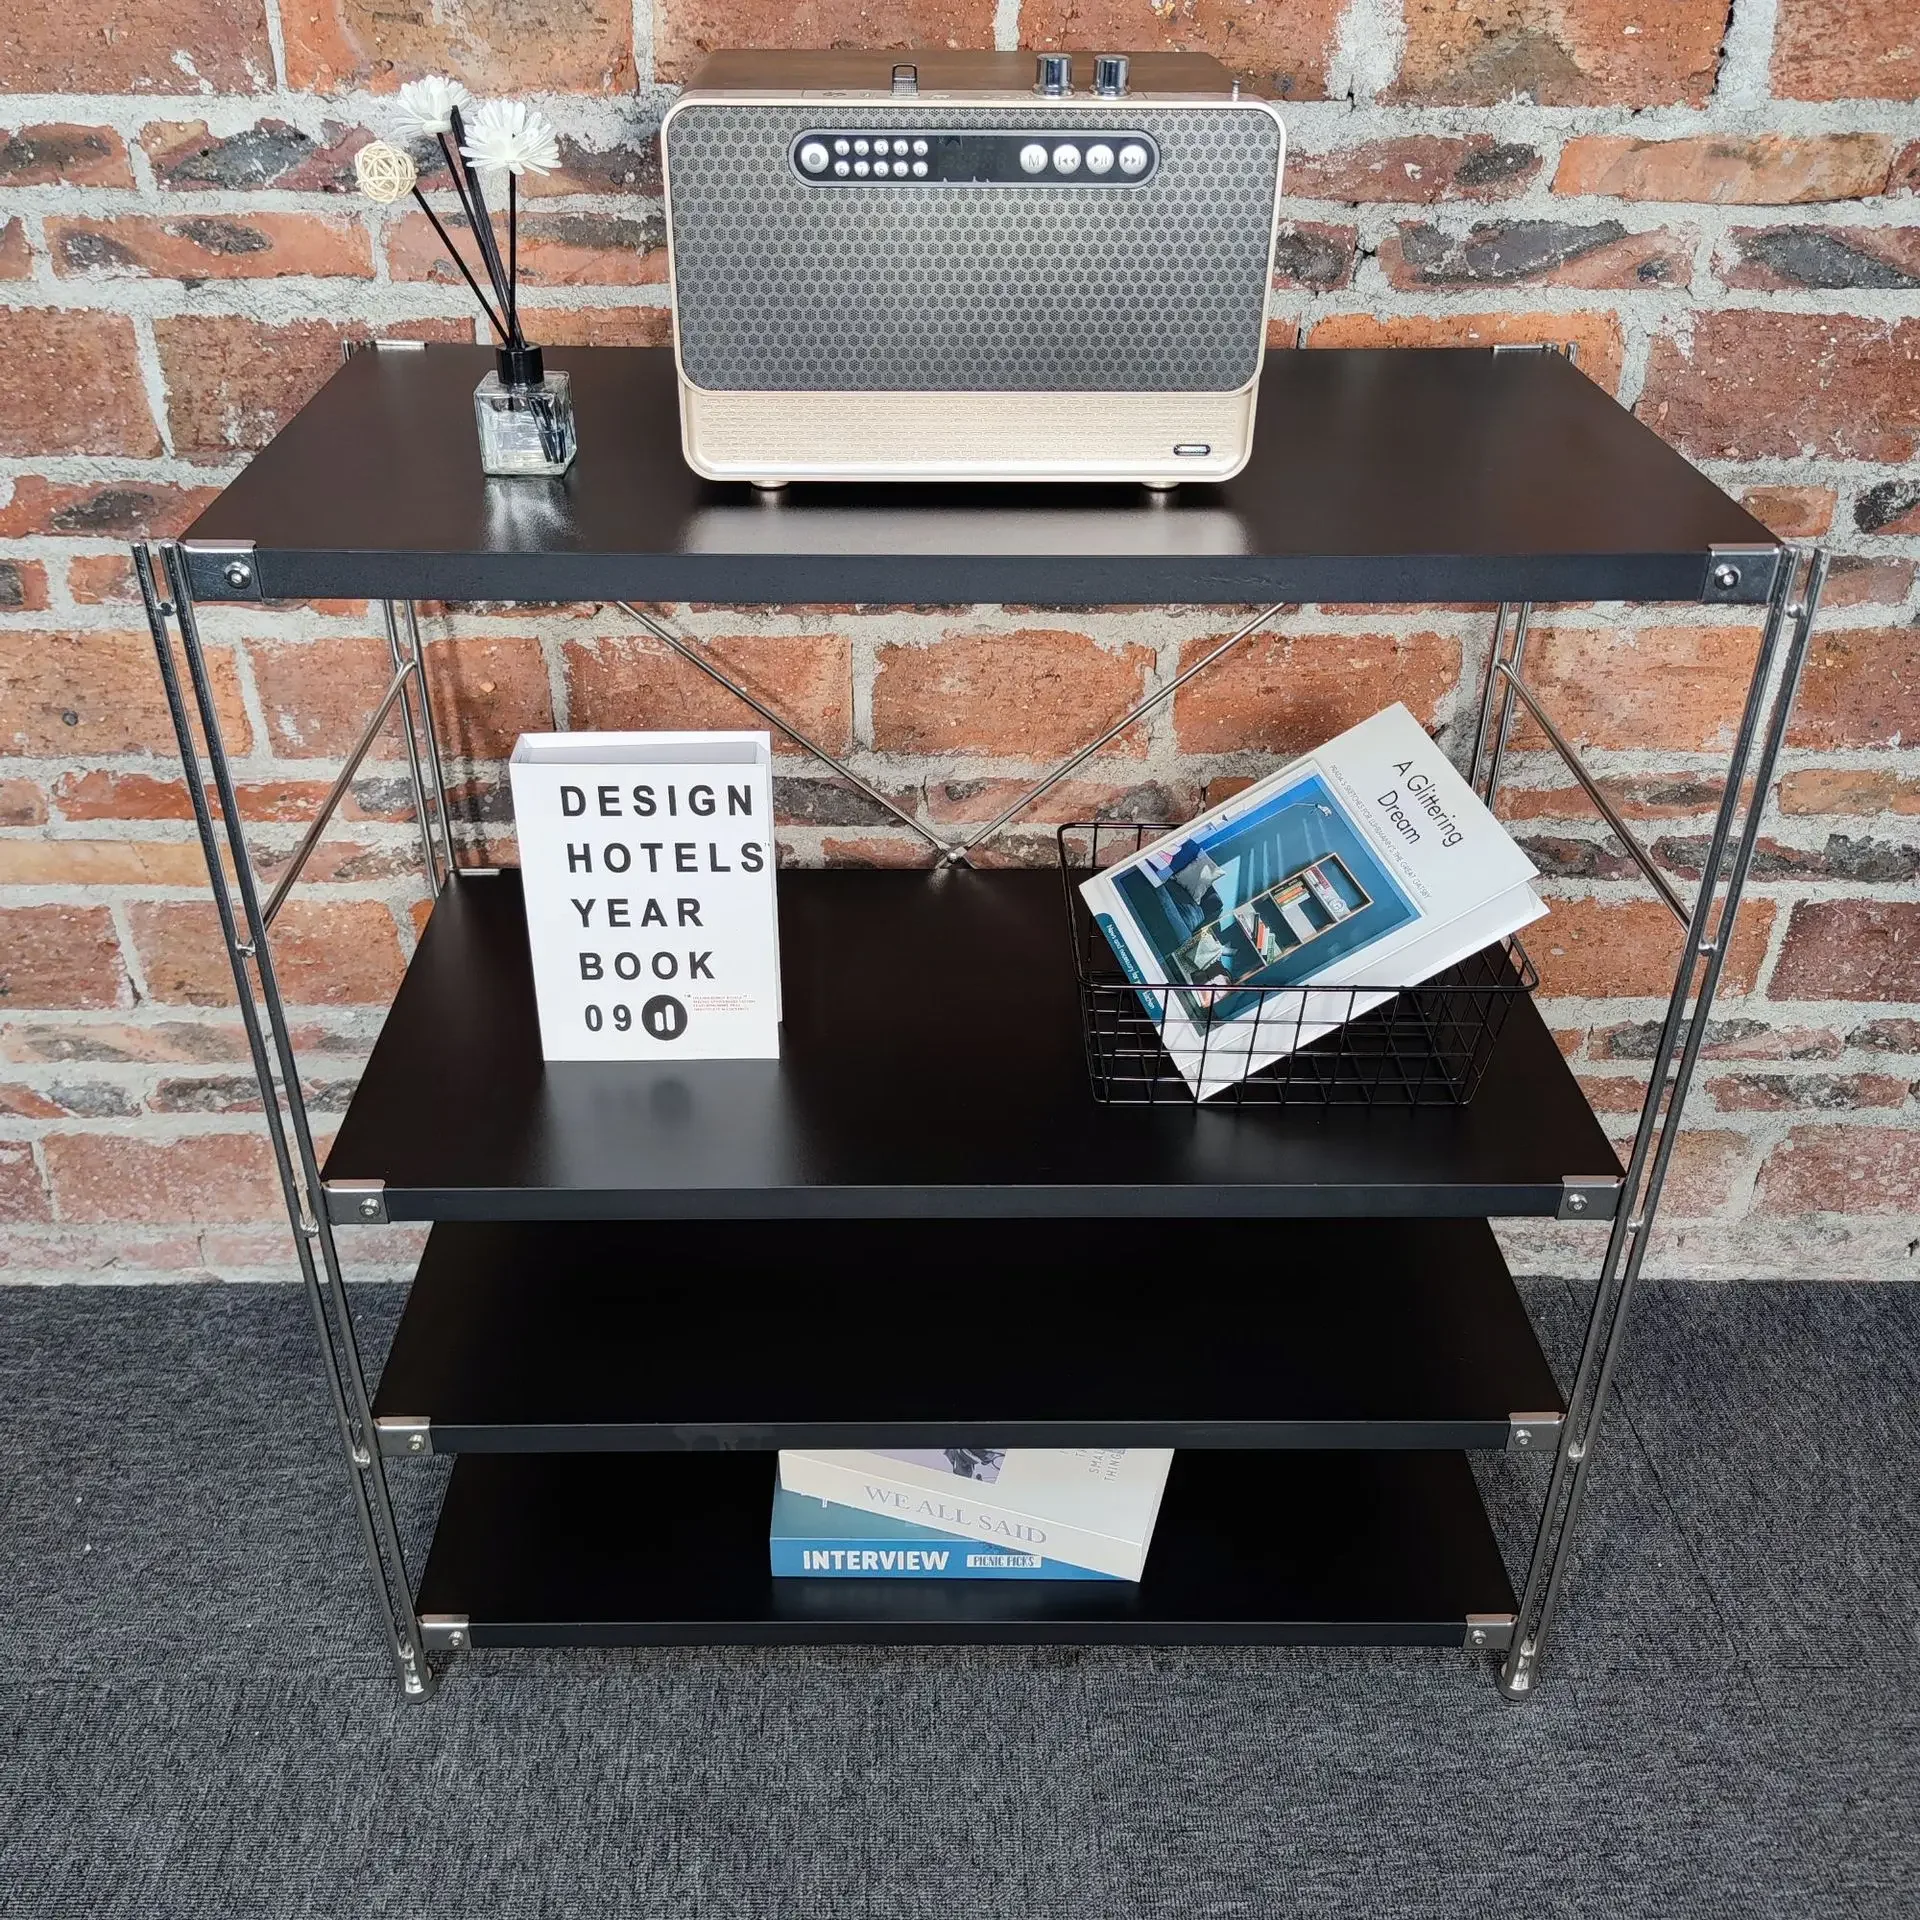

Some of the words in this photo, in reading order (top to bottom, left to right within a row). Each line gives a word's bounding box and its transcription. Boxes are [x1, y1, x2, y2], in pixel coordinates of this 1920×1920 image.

[1028, 154, 1040, 168] M
[560, 784, 753, 817] DESIGN
[1392, 760, 1414, 777] A
[1407, 774, 1464, 848] Glittering
[1377, 790, 1421, 845] Dream
[566, 842, 764, 873] HOTELS
[570, 898, 704, 928] YEAR
[579, 951, 716, 980] BOOK
[584, 1004, 632, 1032] 09
[863, 1485, 911, 1510] WE
[917, 1499, 972, 1526] ALL
[977, 1515, 1048, 1545] SAID
[803, 1550, 950, 1571] INTERVIEW
[973, 1555, 1004, 1567] PICNIC
